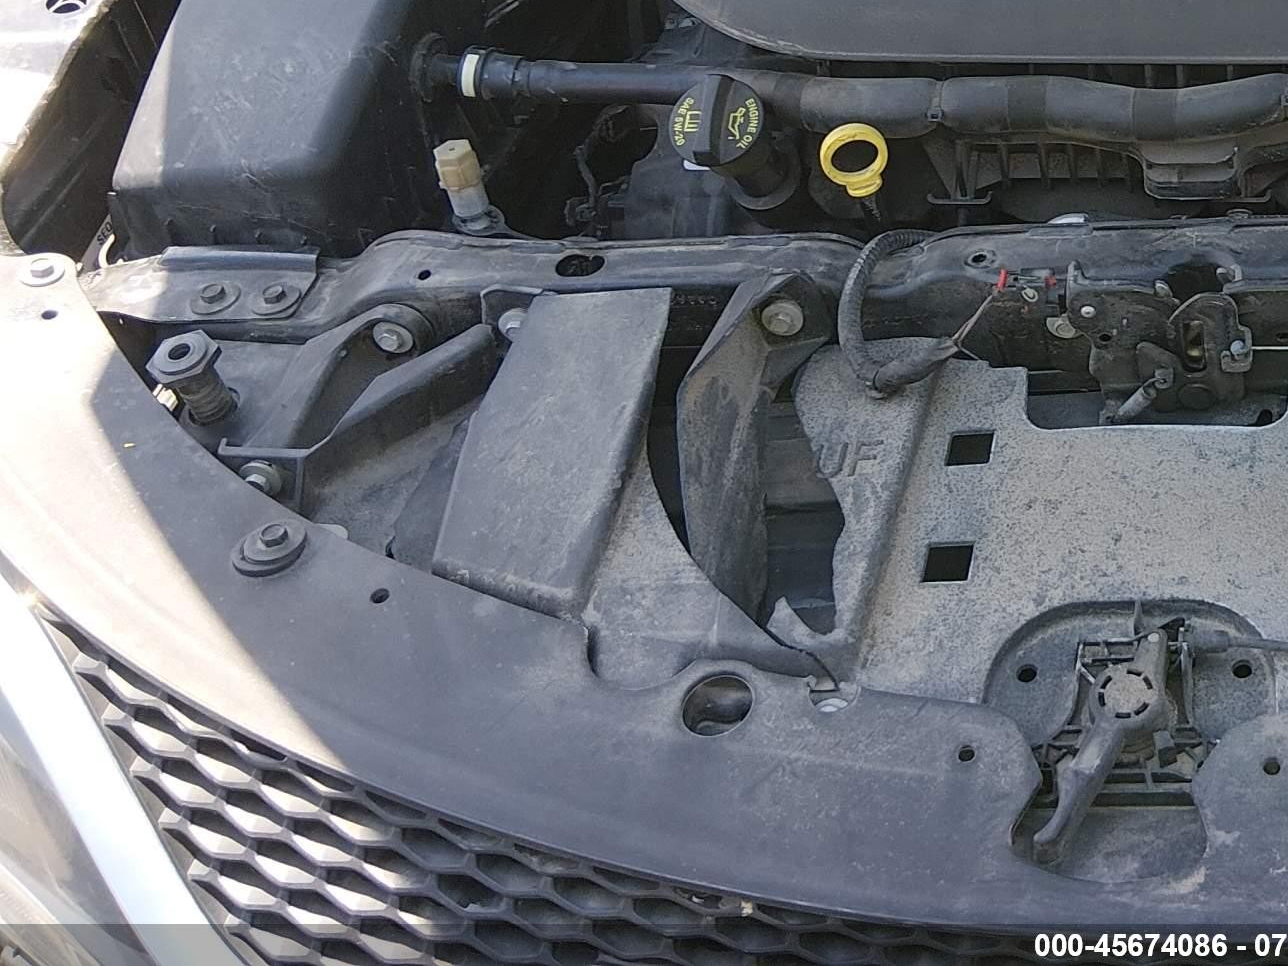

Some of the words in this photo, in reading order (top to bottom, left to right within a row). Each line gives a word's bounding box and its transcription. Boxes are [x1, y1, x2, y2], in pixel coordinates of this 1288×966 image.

[678, 97, 695, 115] SAE
[745, 98, 759, 133] ENGINE
[673, 116, 686, 146] 5W-20
[736, 134, 753, 149] OIL
